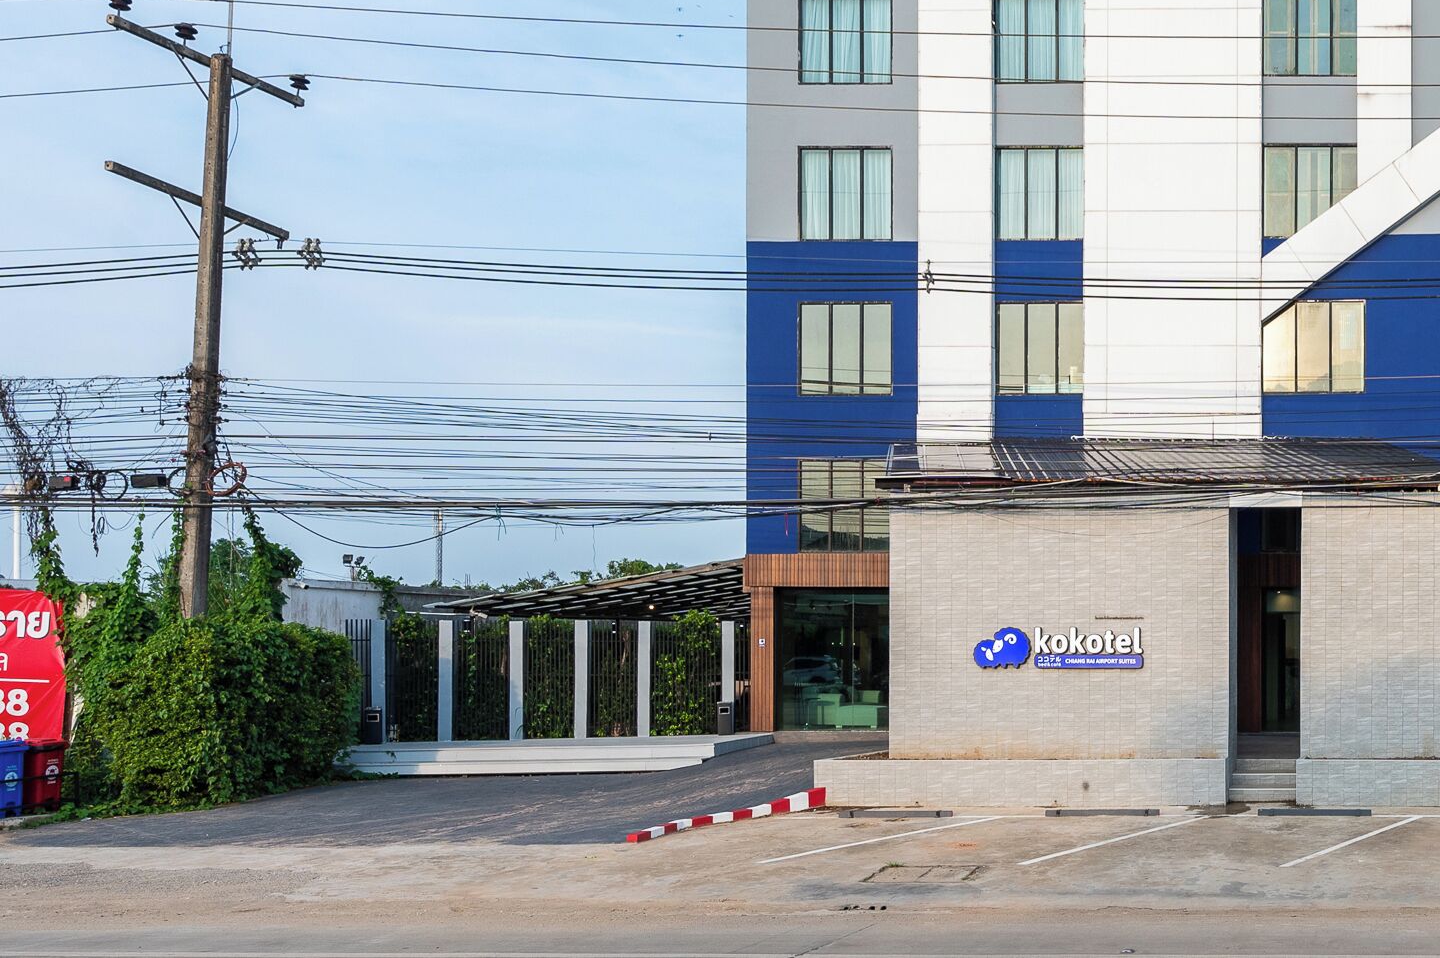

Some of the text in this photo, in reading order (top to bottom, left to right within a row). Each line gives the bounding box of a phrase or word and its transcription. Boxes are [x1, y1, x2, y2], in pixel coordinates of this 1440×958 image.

[1034, 627, 1143, 654] kokotel
[0, 688, 29, 716] 8
[0, 722, 29, 740] 8
